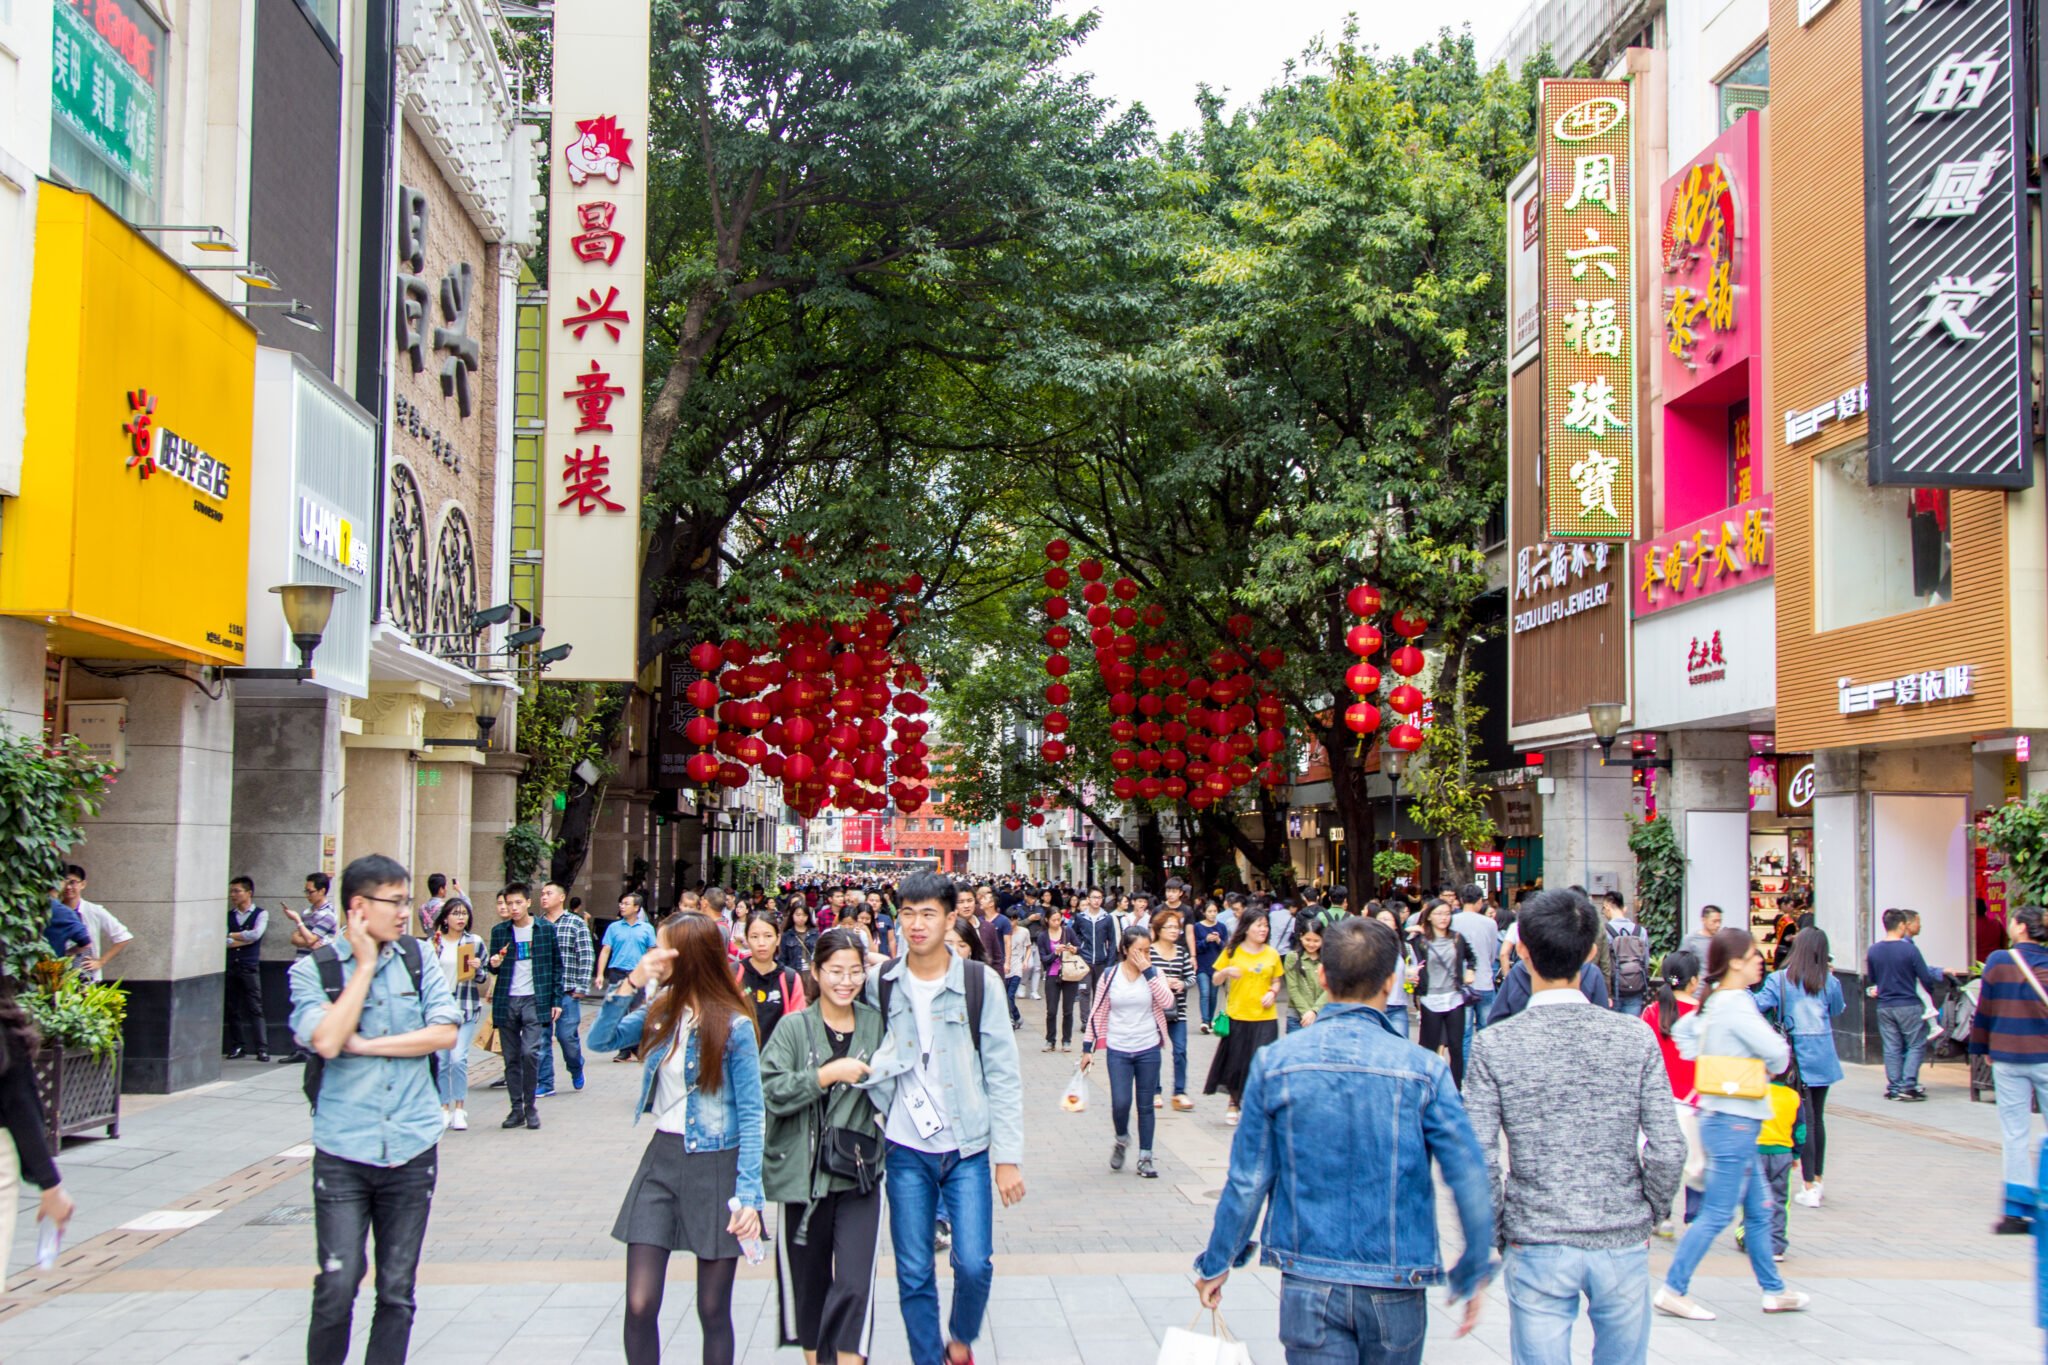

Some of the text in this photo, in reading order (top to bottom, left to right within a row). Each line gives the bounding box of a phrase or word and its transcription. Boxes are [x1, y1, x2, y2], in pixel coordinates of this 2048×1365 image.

[1902, 0, 2006, 341] 的感觉
[558, 201, 631, 516] 昌兴童装
[1563, 153, 1628, 519] 周六福珠寶
[158, 427, 231, 500] 阳光名店
[1641, 508, 1769, 603] 羊蝎子火锅
[1514, 608, 1537, 634] ZHOU
[1551, 598, 1564, 621] FU
[1564, 581, 1609, 617] JEWELRY
[669, 640, 707, 740] 商场
[1895, 664, 1972, 706] 爱依服
